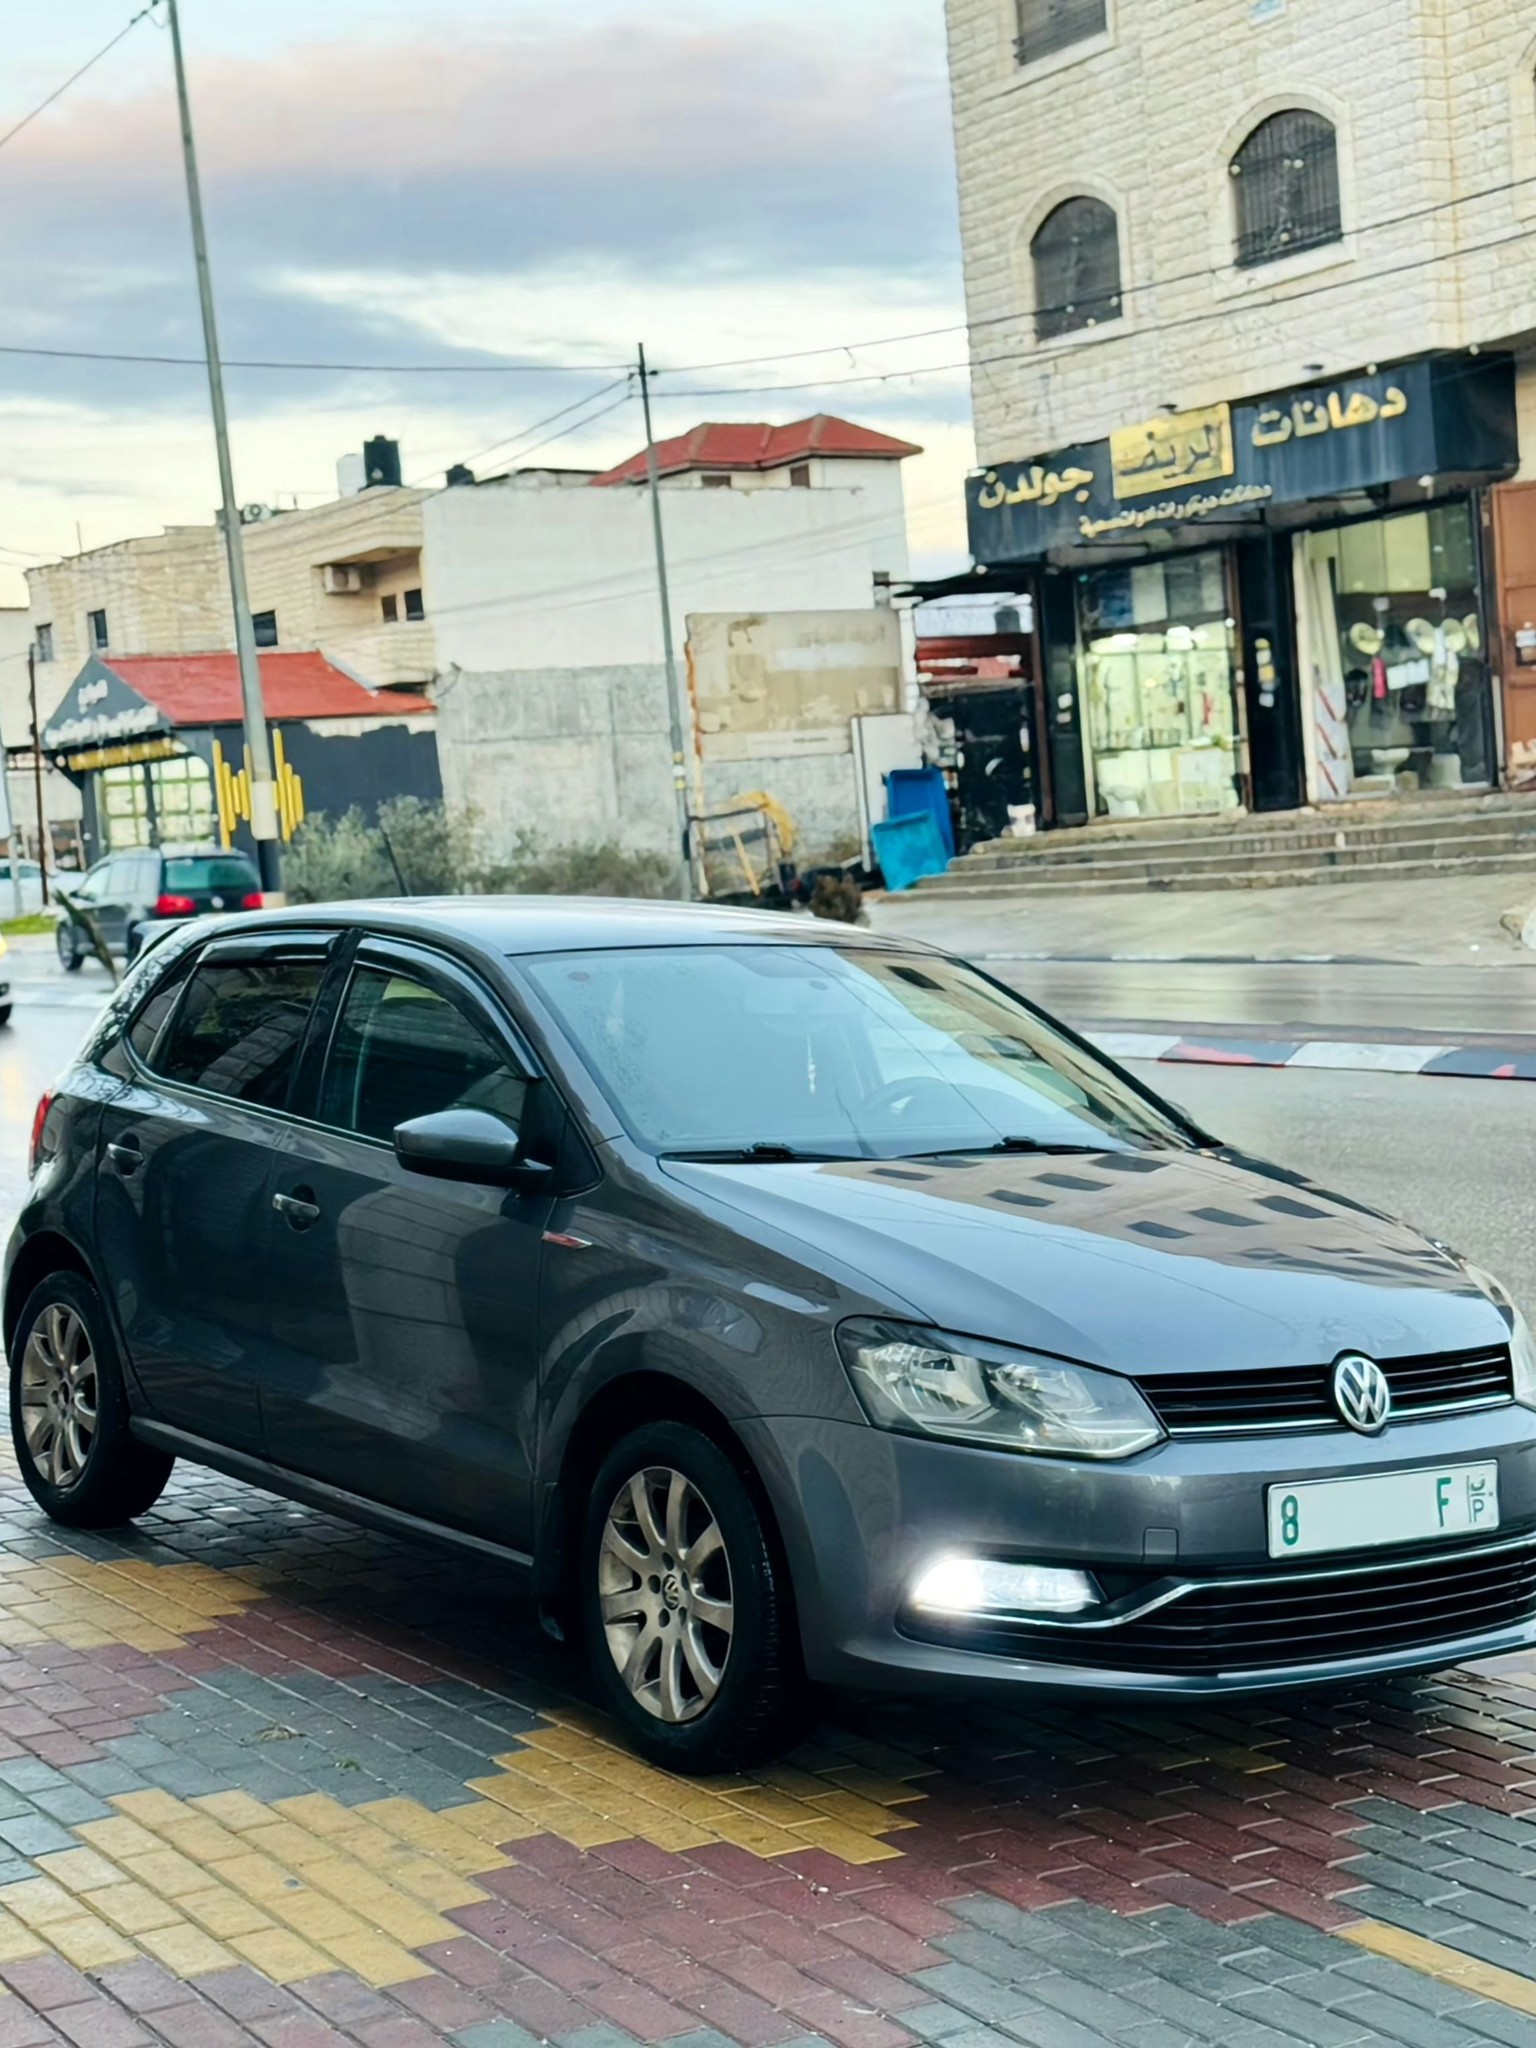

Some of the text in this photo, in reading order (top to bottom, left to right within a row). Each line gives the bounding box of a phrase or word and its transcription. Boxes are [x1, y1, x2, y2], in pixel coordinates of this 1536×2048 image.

[1251, 386, 1407, 447] دهانات
[978, 466, 1094, 508] جولدن
[1334, 1356, 1390, 1432] VW
[1281, 1477, 1452, 1546] 8 F
[1472, 1498, 1485, 1522] P
